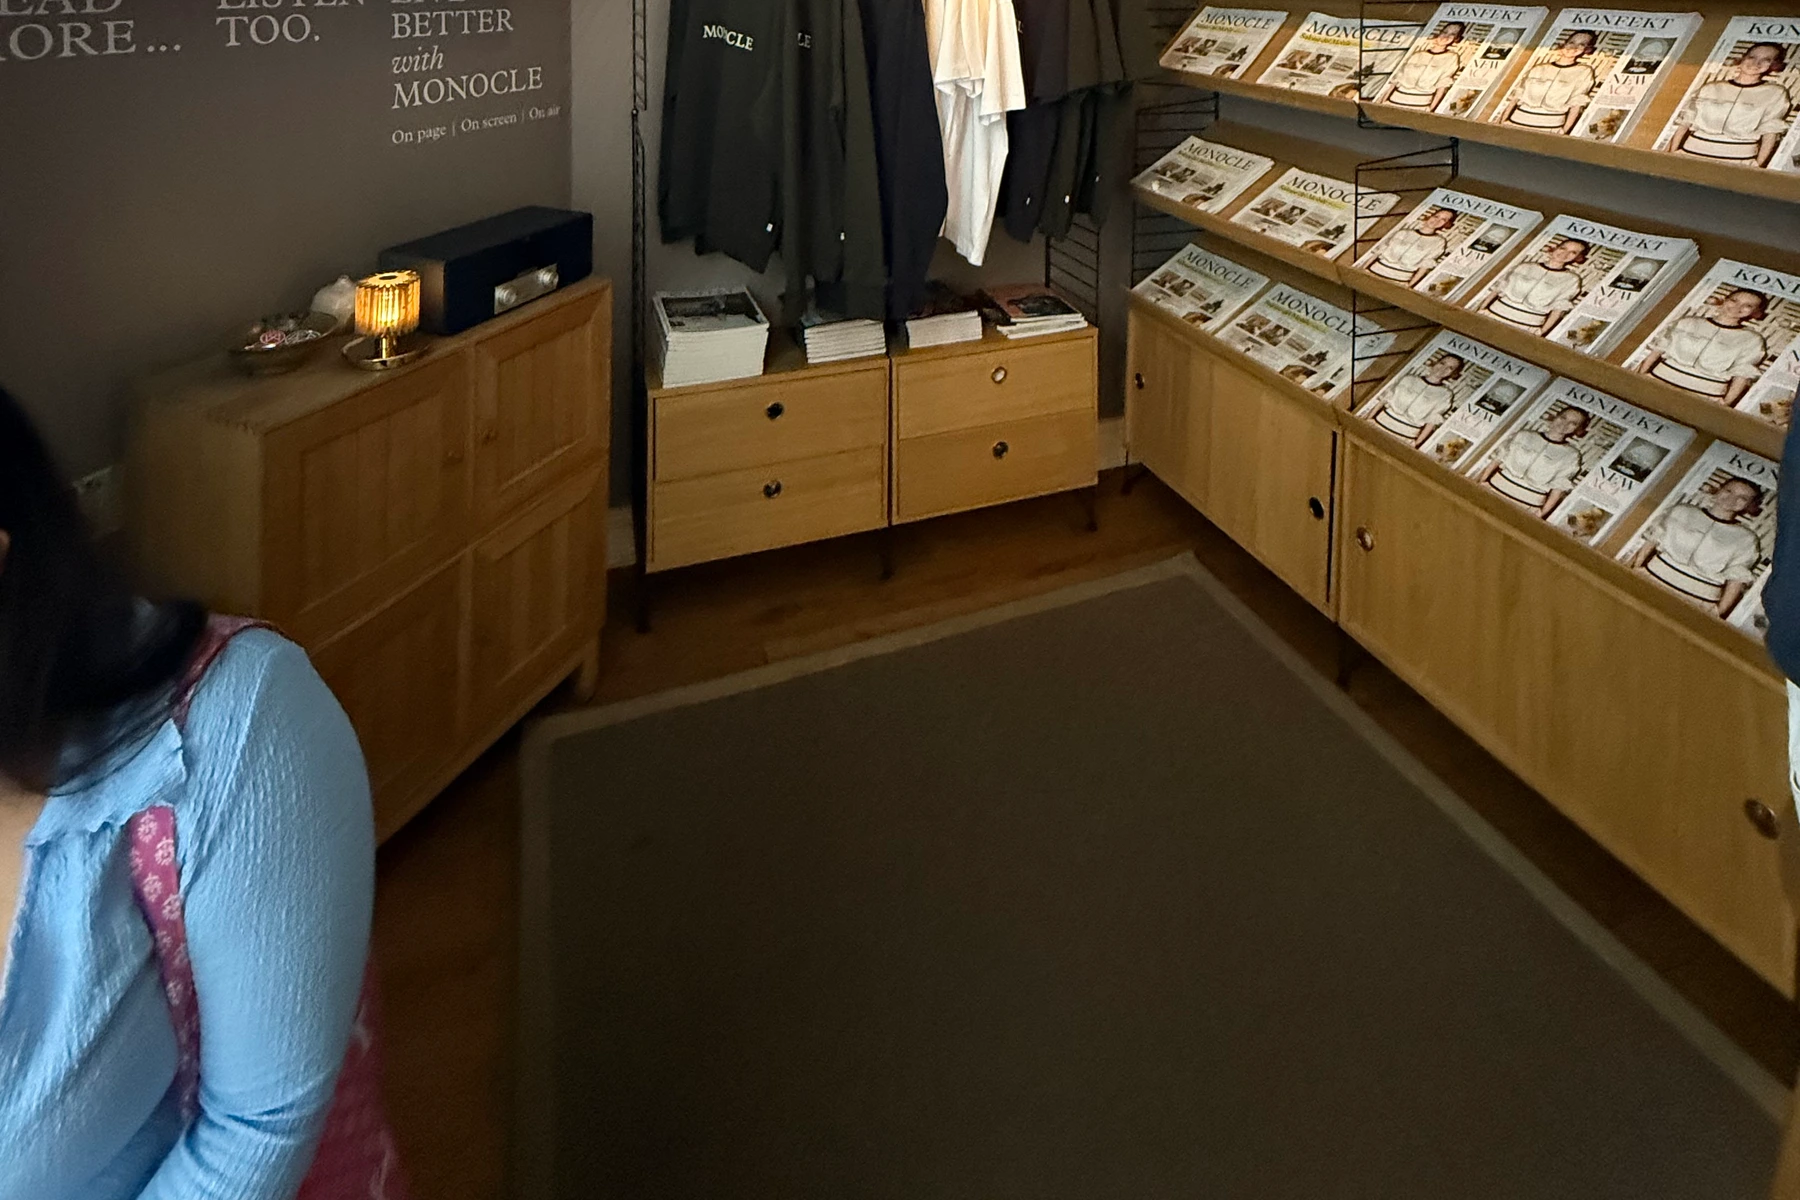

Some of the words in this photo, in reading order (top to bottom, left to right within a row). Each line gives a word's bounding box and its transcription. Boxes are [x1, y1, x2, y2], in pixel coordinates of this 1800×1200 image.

[391, 8, 514, 39] BETTER
[1201, 13, 1275, 30] MONOCLE
[1446, 6, 1527, 22] KONFEKT
[1571, 12, 1675, 30] KONFEKT
[0, 19, 181, 61] ORE...
[215, 13, 320, 47] TOO.
[1306, 20, 1406, 44] MONOCLE
[391, 45, 443, 74] with
[391, 66, 543, 109] MONOCLE
[392, 129, 414, 144] On
[417, 124, 447, 143] page
[461, 118, 479, 132] On
[482, 113, 517, 129] screen
[529, 106, 545, 118] On
[547, 104, 561, 116] air
[1287, 176, 1382, 211] MONOCLE
[1441, 193, 1521, 221] KONFEKT
[1566, 221, 1669, 252] KONFEKT
[1566, 386, 1671, 435] KONFEKT
